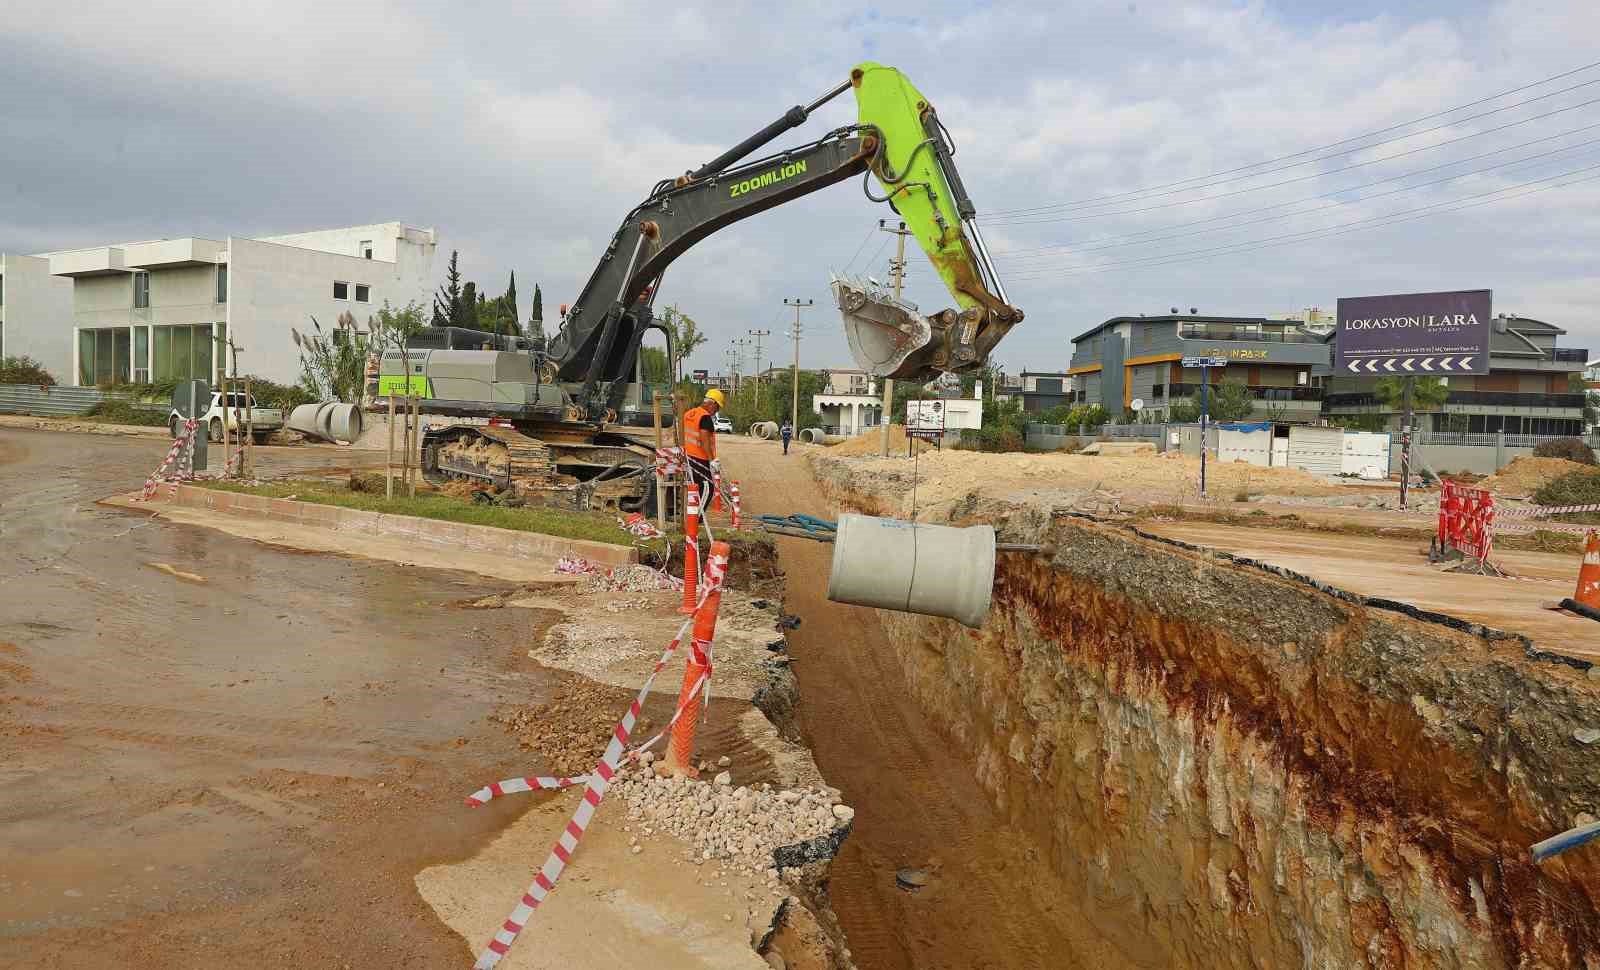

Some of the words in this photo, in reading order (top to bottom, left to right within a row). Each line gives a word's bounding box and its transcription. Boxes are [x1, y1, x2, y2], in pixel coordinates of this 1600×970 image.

[729, 160, 807, 198] ZOOMLION
[1345, 316, 1419, 330] LOKASYON
[1428, 313, 1480, 327] LARA
